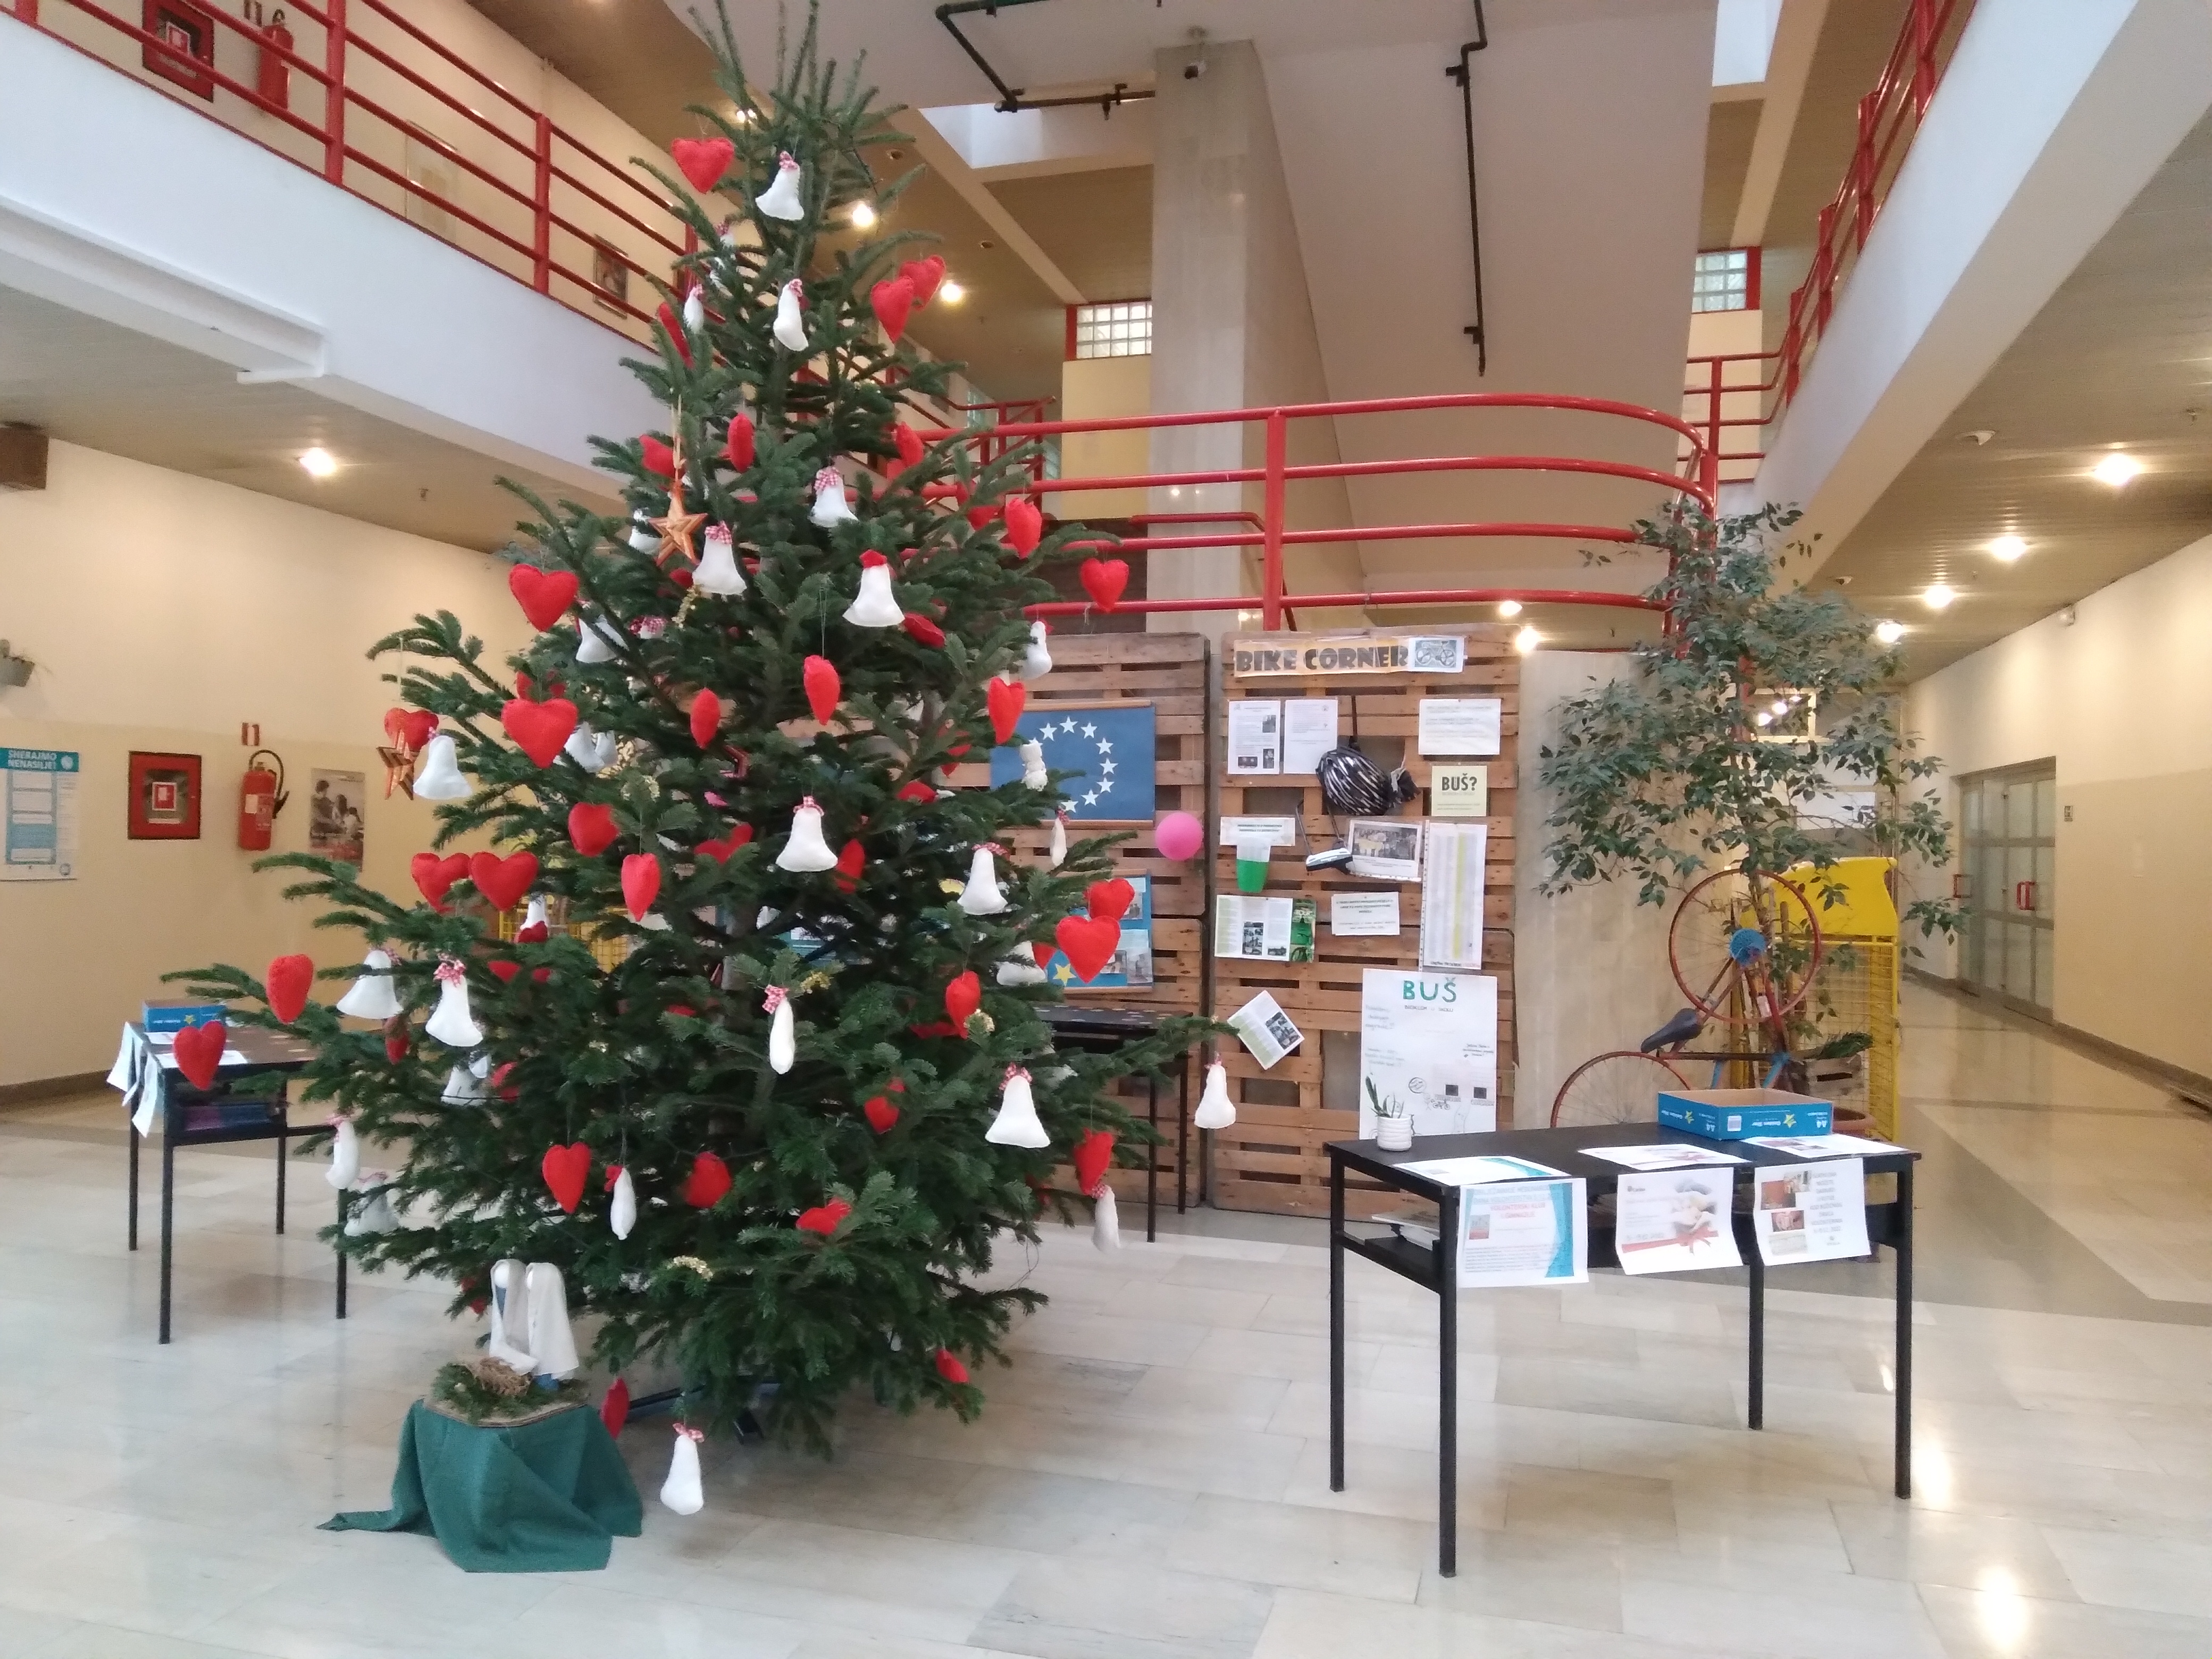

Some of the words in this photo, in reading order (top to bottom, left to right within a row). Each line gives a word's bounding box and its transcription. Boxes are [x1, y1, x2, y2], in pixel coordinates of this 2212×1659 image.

[1236, 649, 1297, 672] BIKE
[1304, 646, 1409, 669] CORNER
[1442, 773, 1478, 791] BUŠ?
[1403, 977, 1457, 1003] BUŠ
